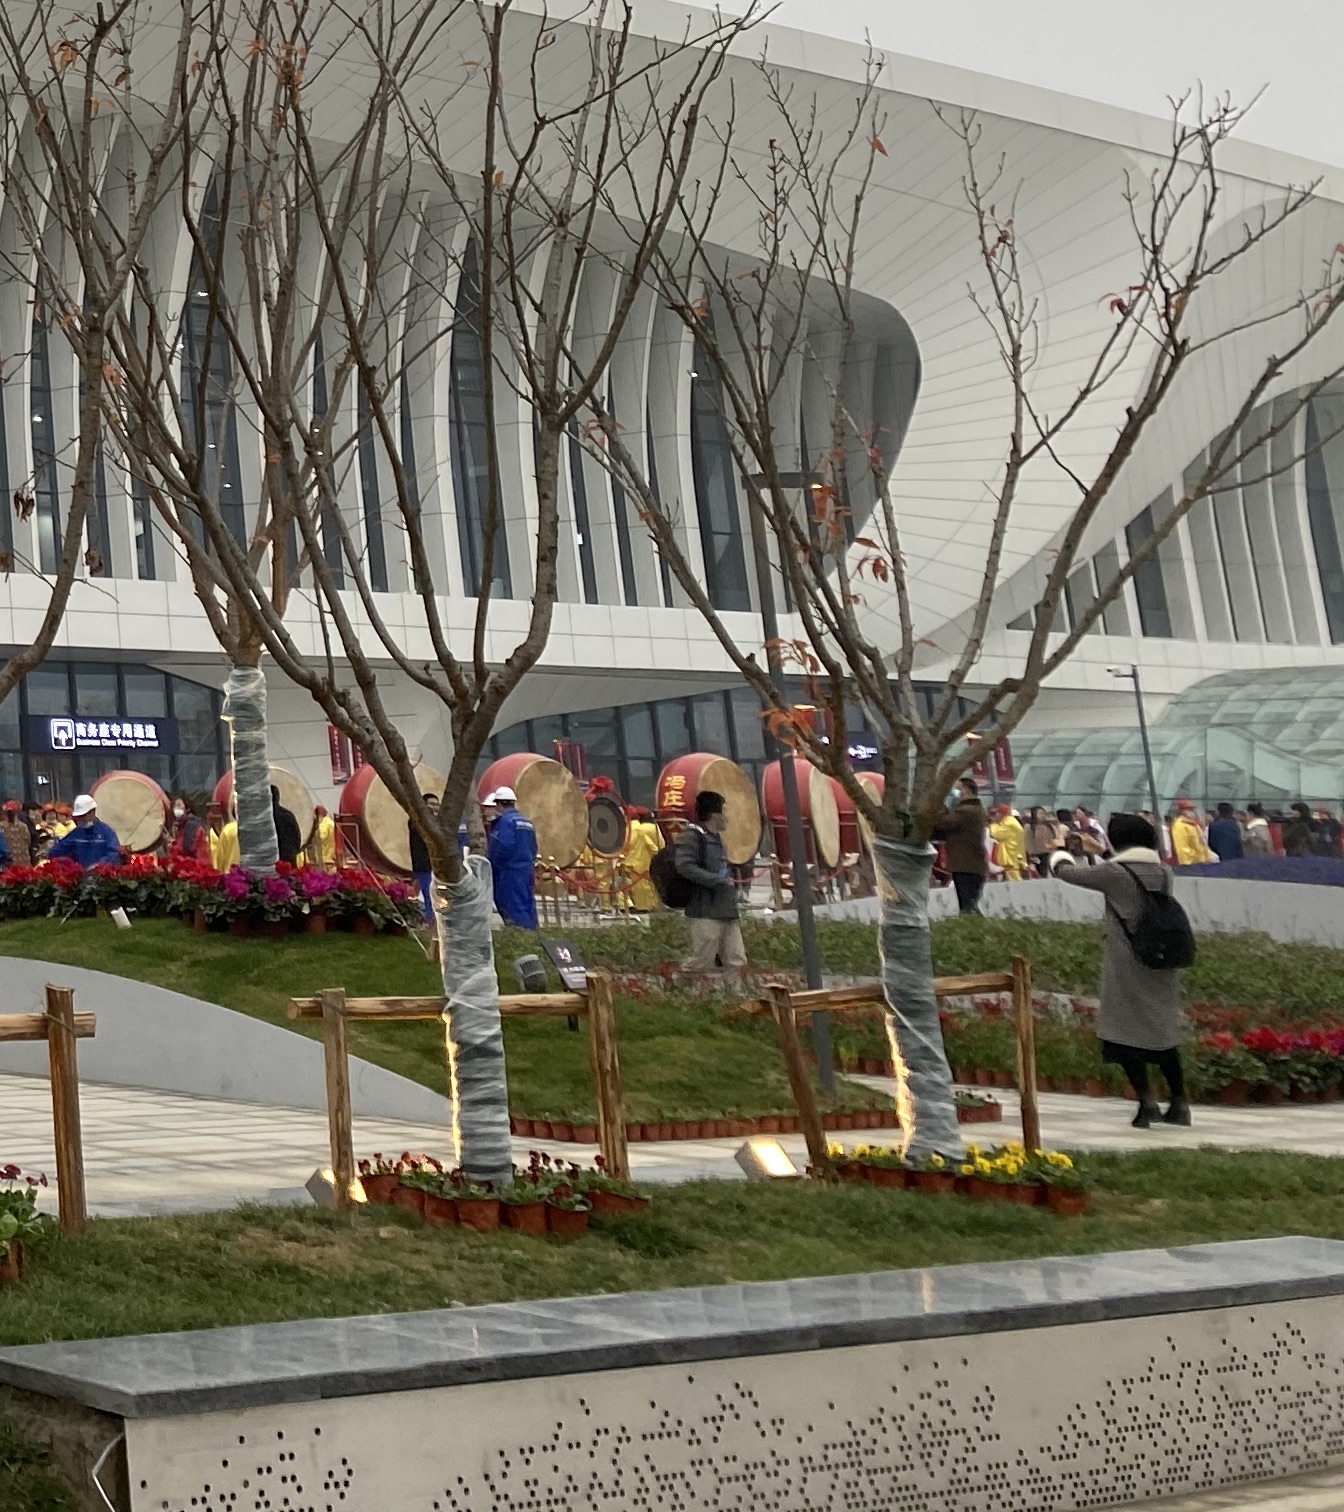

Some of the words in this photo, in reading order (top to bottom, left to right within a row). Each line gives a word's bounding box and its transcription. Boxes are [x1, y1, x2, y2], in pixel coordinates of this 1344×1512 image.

[75, 721, 156, 739] 商务座专用通道
